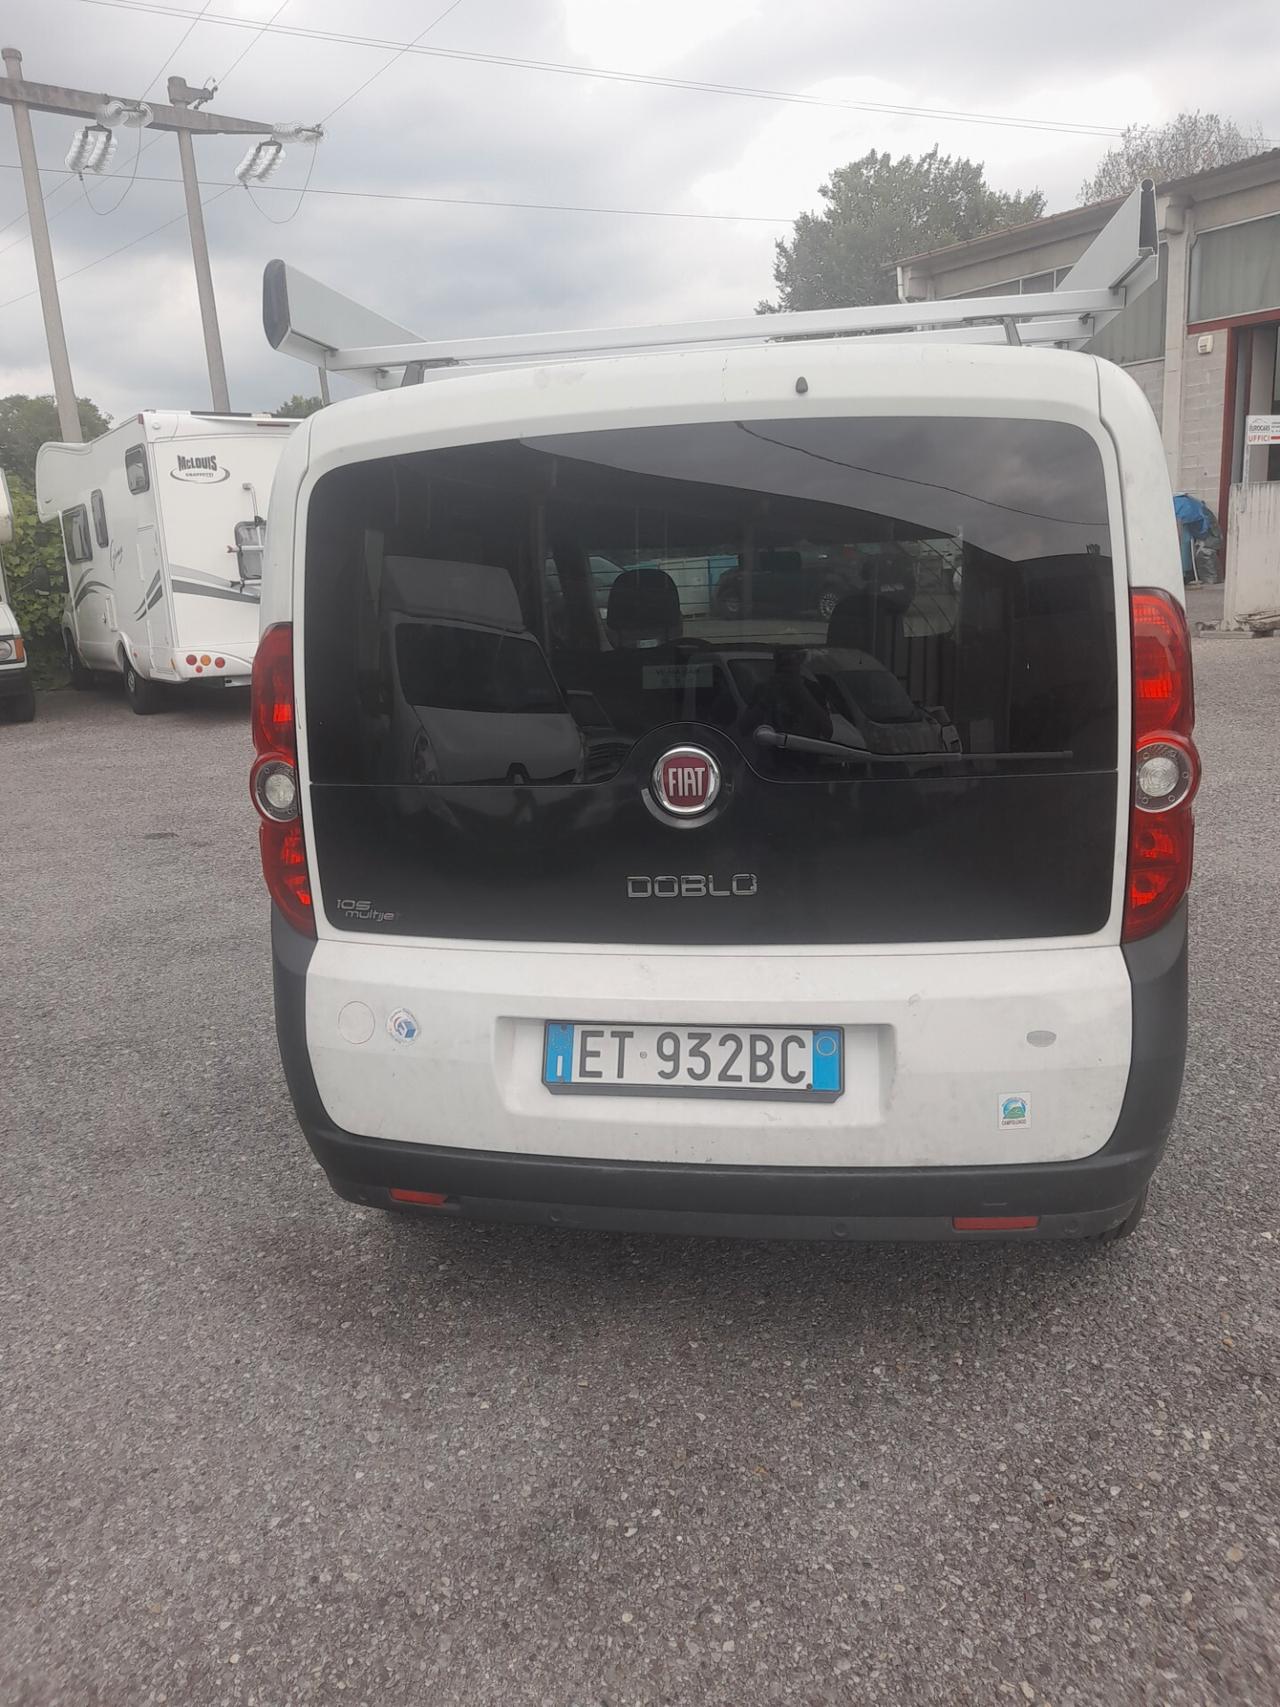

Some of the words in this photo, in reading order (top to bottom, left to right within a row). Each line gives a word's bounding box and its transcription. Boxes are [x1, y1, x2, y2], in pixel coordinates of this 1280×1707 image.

[1248, 434, 1271, 442] UFFICI
[177, 454, 217, 471] McLOUIS
[668, 767, 705, 797] FIAT
[578, 1030, 635, 1079] ET
[656, 1031, 807, 1084] 932BC
